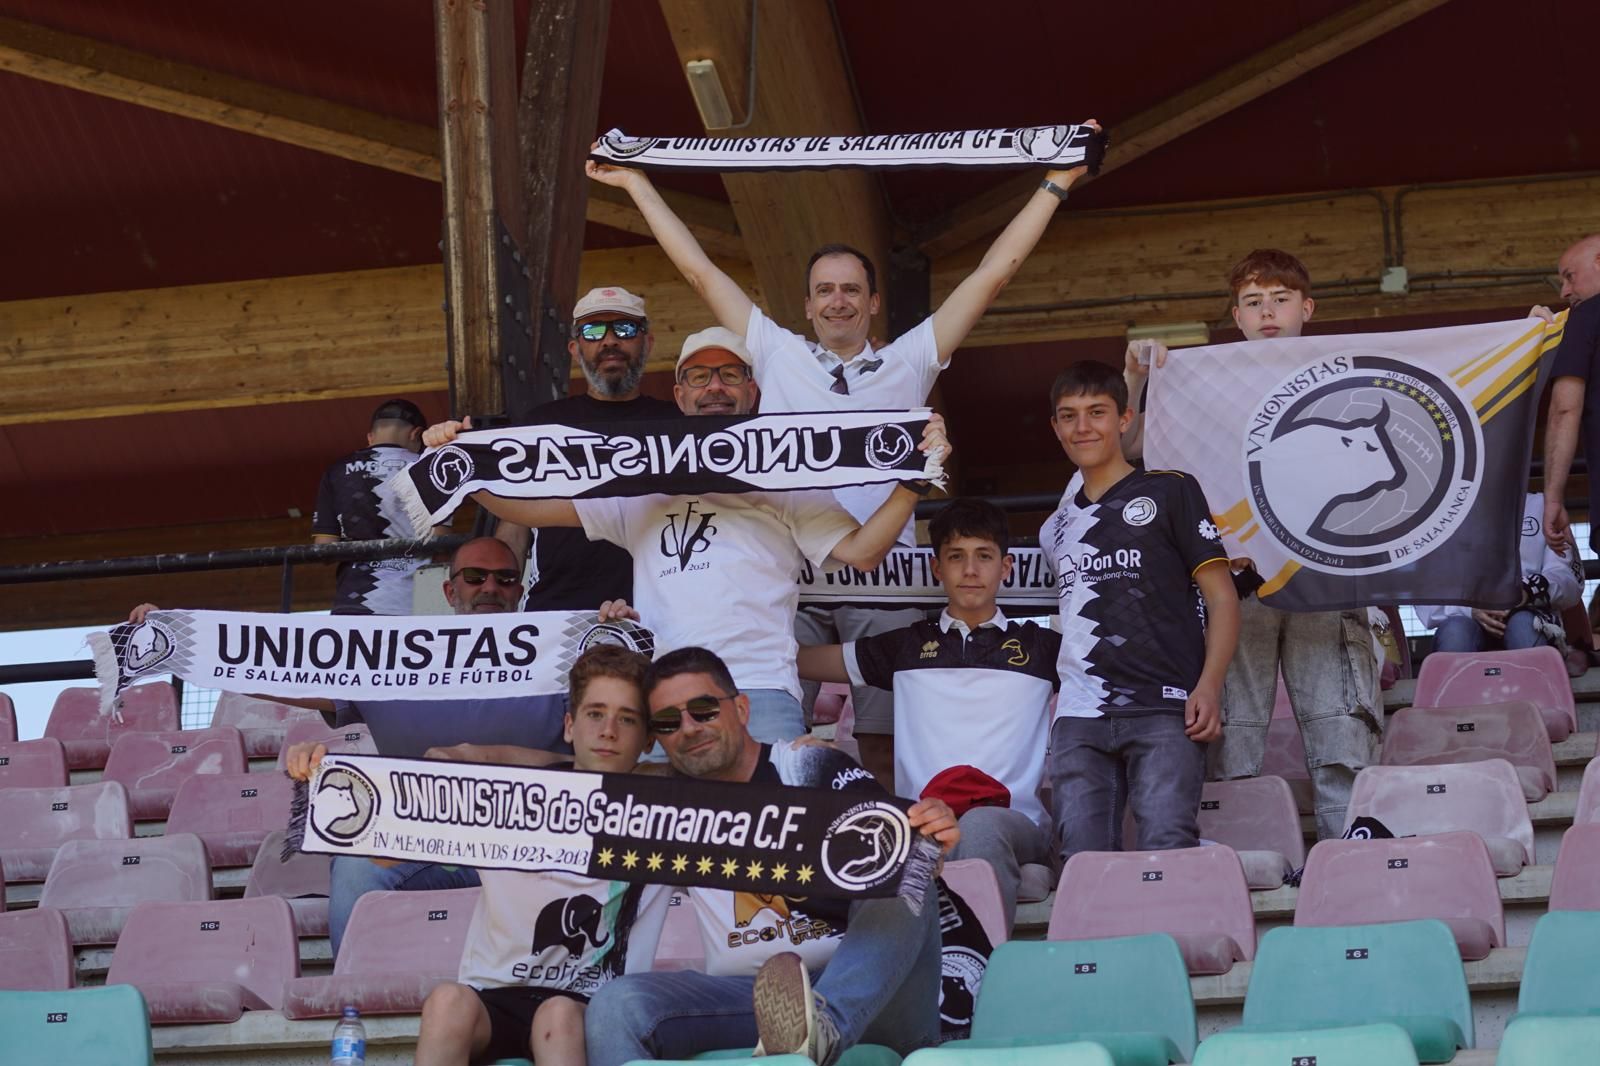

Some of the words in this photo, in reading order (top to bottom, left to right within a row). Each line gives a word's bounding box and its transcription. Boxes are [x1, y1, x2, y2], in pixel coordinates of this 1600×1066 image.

[1394, 545, 1413, 559] DE
[1413, 486, 1470, 550] SALAMANCA
[1080, 554, 1112, 571] Don
[1115, 549, 1142, 568] QR
[218, 624, 540, 670] UNIONISTAS
[213, 666, 237, 679] DE
[245, 668, 362, 686] SALAMANCA
[371, 673, 418, 686] CLUB
[428, 672, 451, 685] DE
[460, 668, 533, 684] FÚTBOL
[389, 771, 547, 831] UNIONISTAS
[547, 790, 584, 834] de
[584, 788, 752, 847] Salamanca
[753, 805, 806, 851] C.F.
[479, 842, 509, 860] VDS
